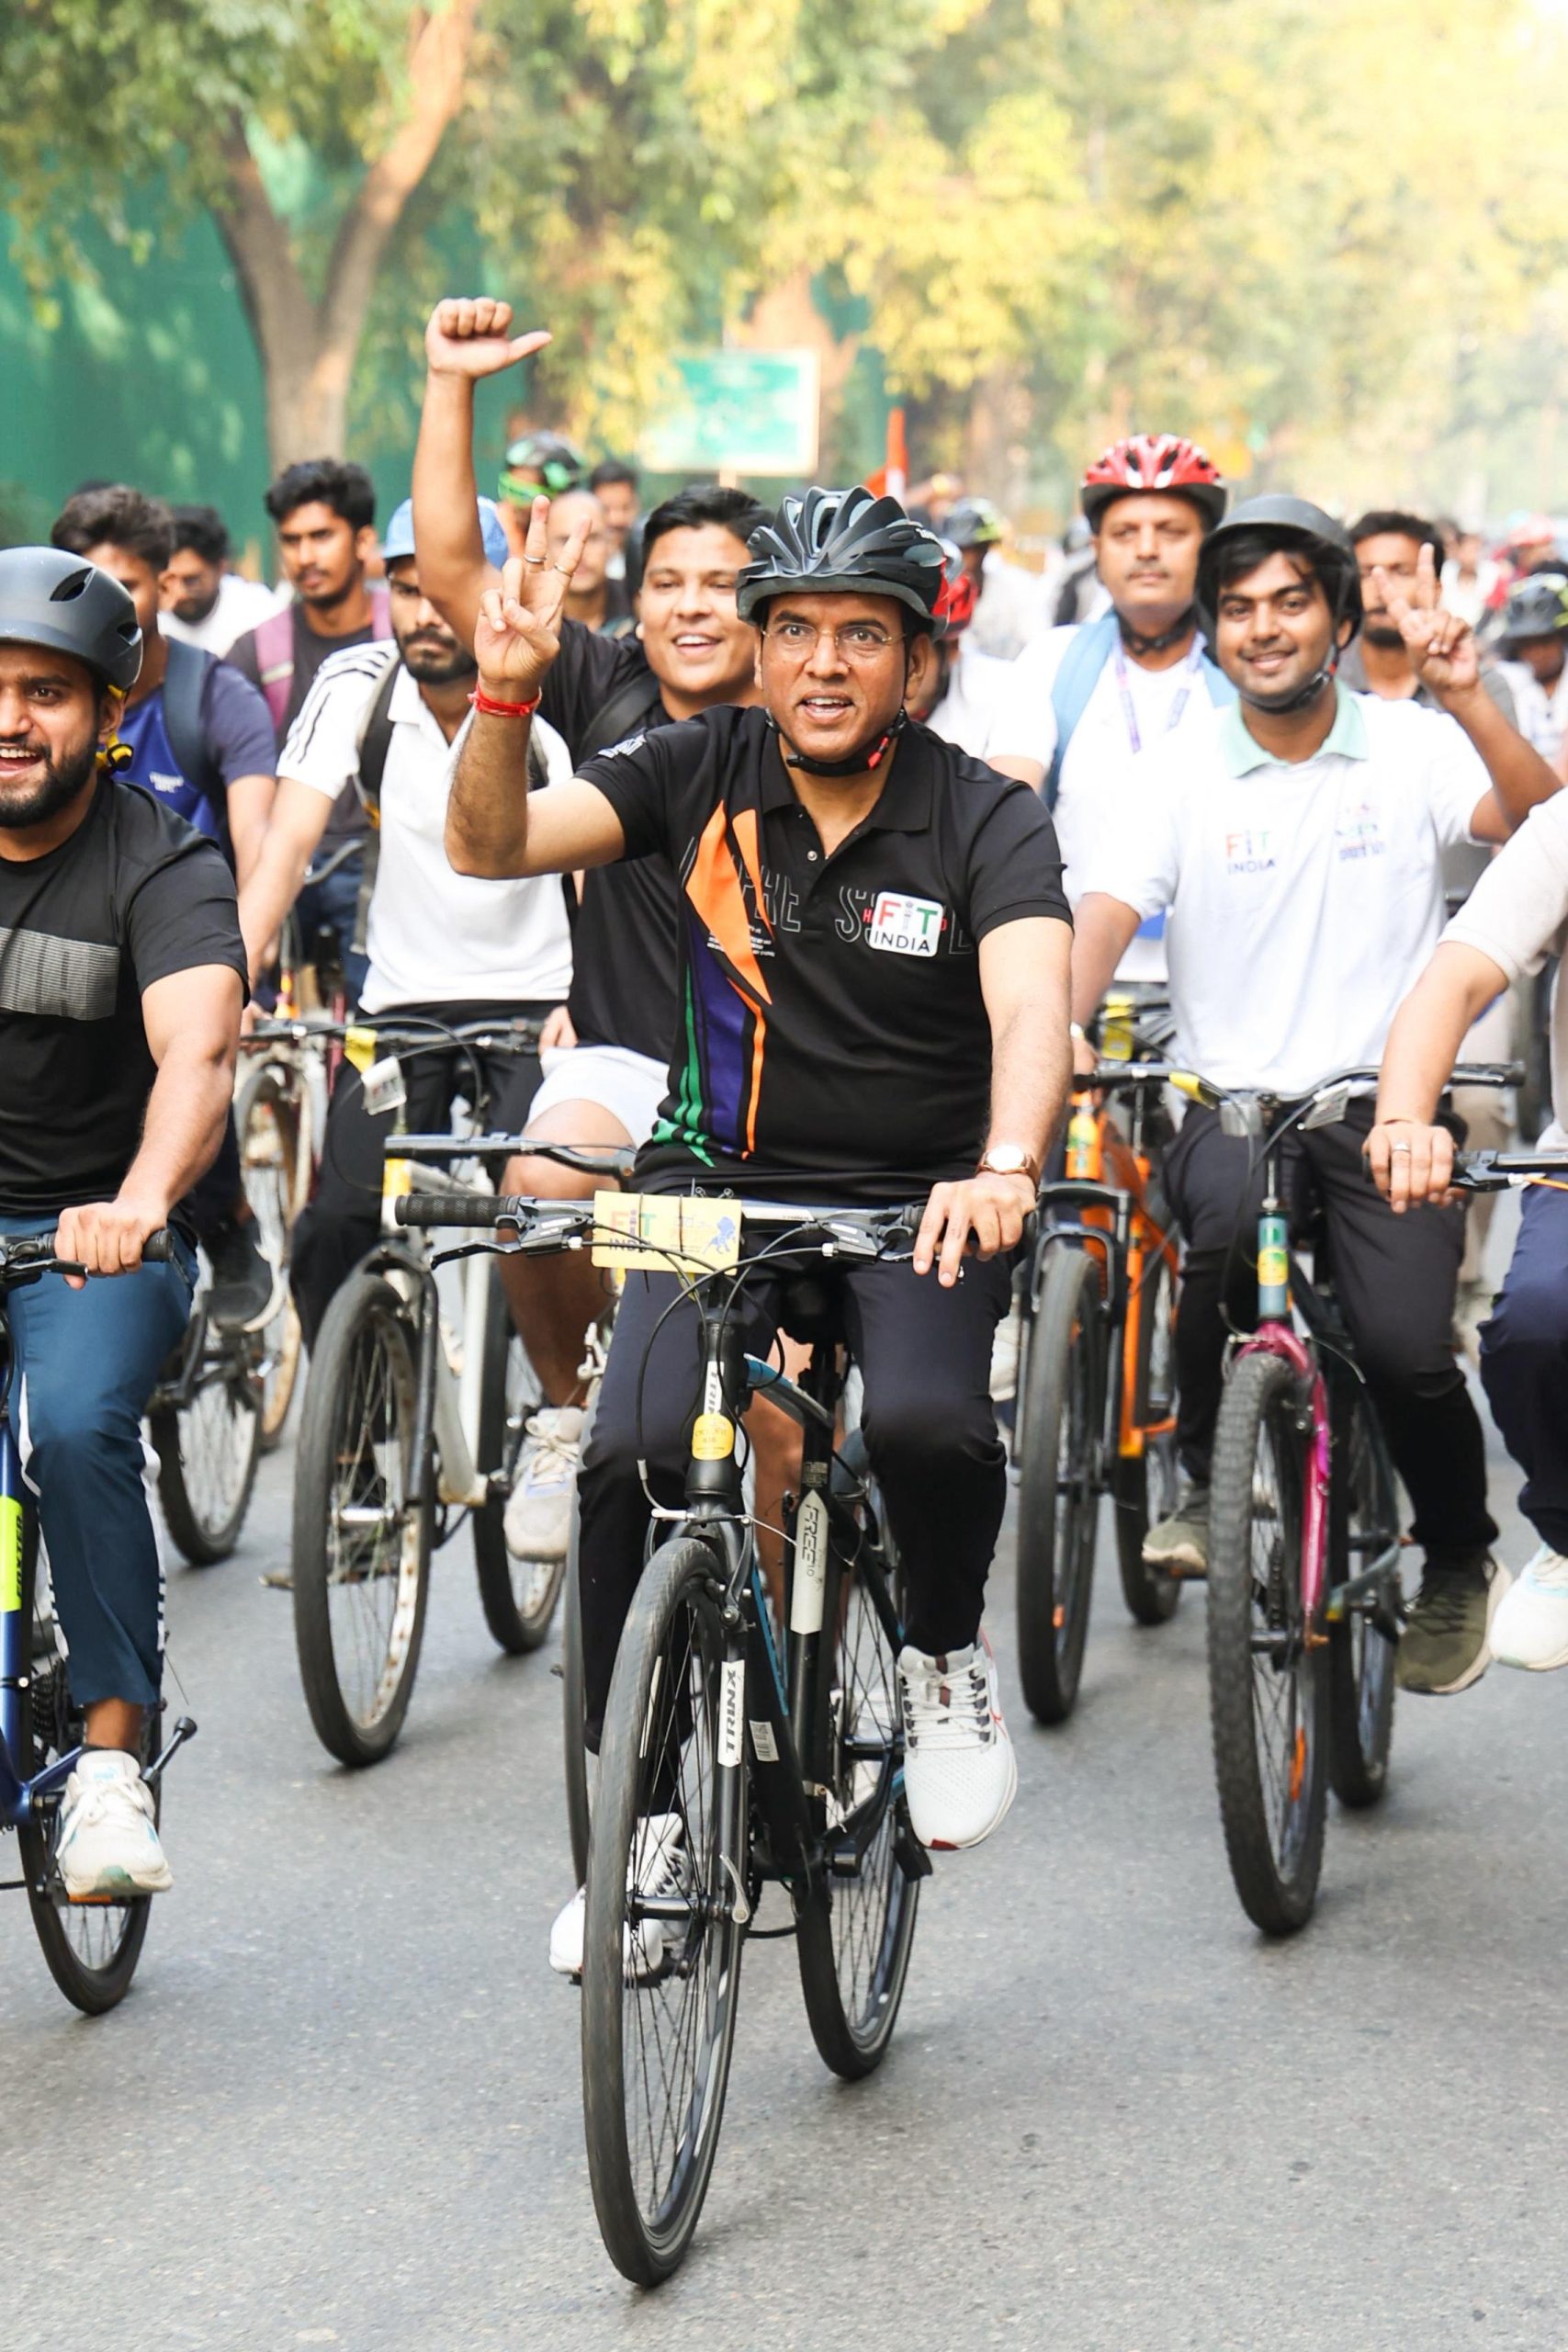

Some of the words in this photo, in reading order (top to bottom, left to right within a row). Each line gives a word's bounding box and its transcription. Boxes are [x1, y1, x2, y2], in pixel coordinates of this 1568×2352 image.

[873, 930, 931, 954] INDIA
[801, 1504, 819, 1564] FREE
[726, 1668, 736, 1753] TRINX
